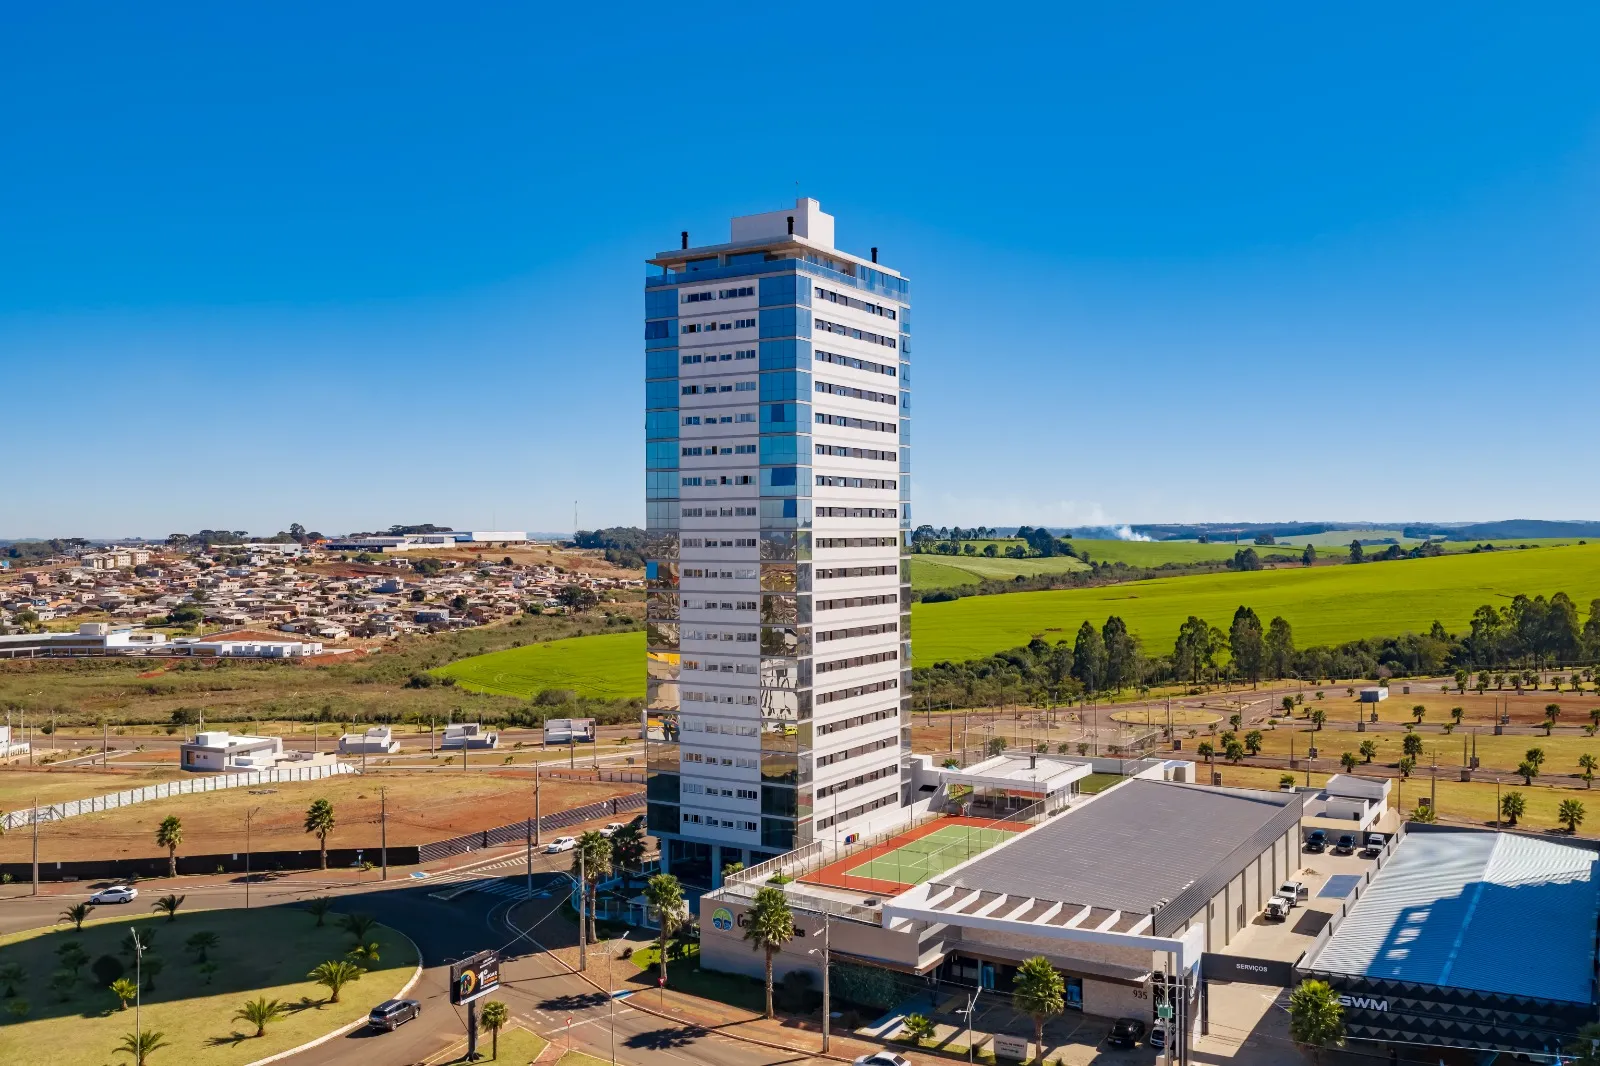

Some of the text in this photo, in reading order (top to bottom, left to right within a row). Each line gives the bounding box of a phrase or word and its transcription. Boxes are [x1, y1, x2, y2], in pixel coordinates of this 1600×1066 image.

[1236, 963, 1268, 973] SERVIÇOS
[1133, 989, 1148, 1000] 935
[1337, 994, 1388, 1012] GWM
